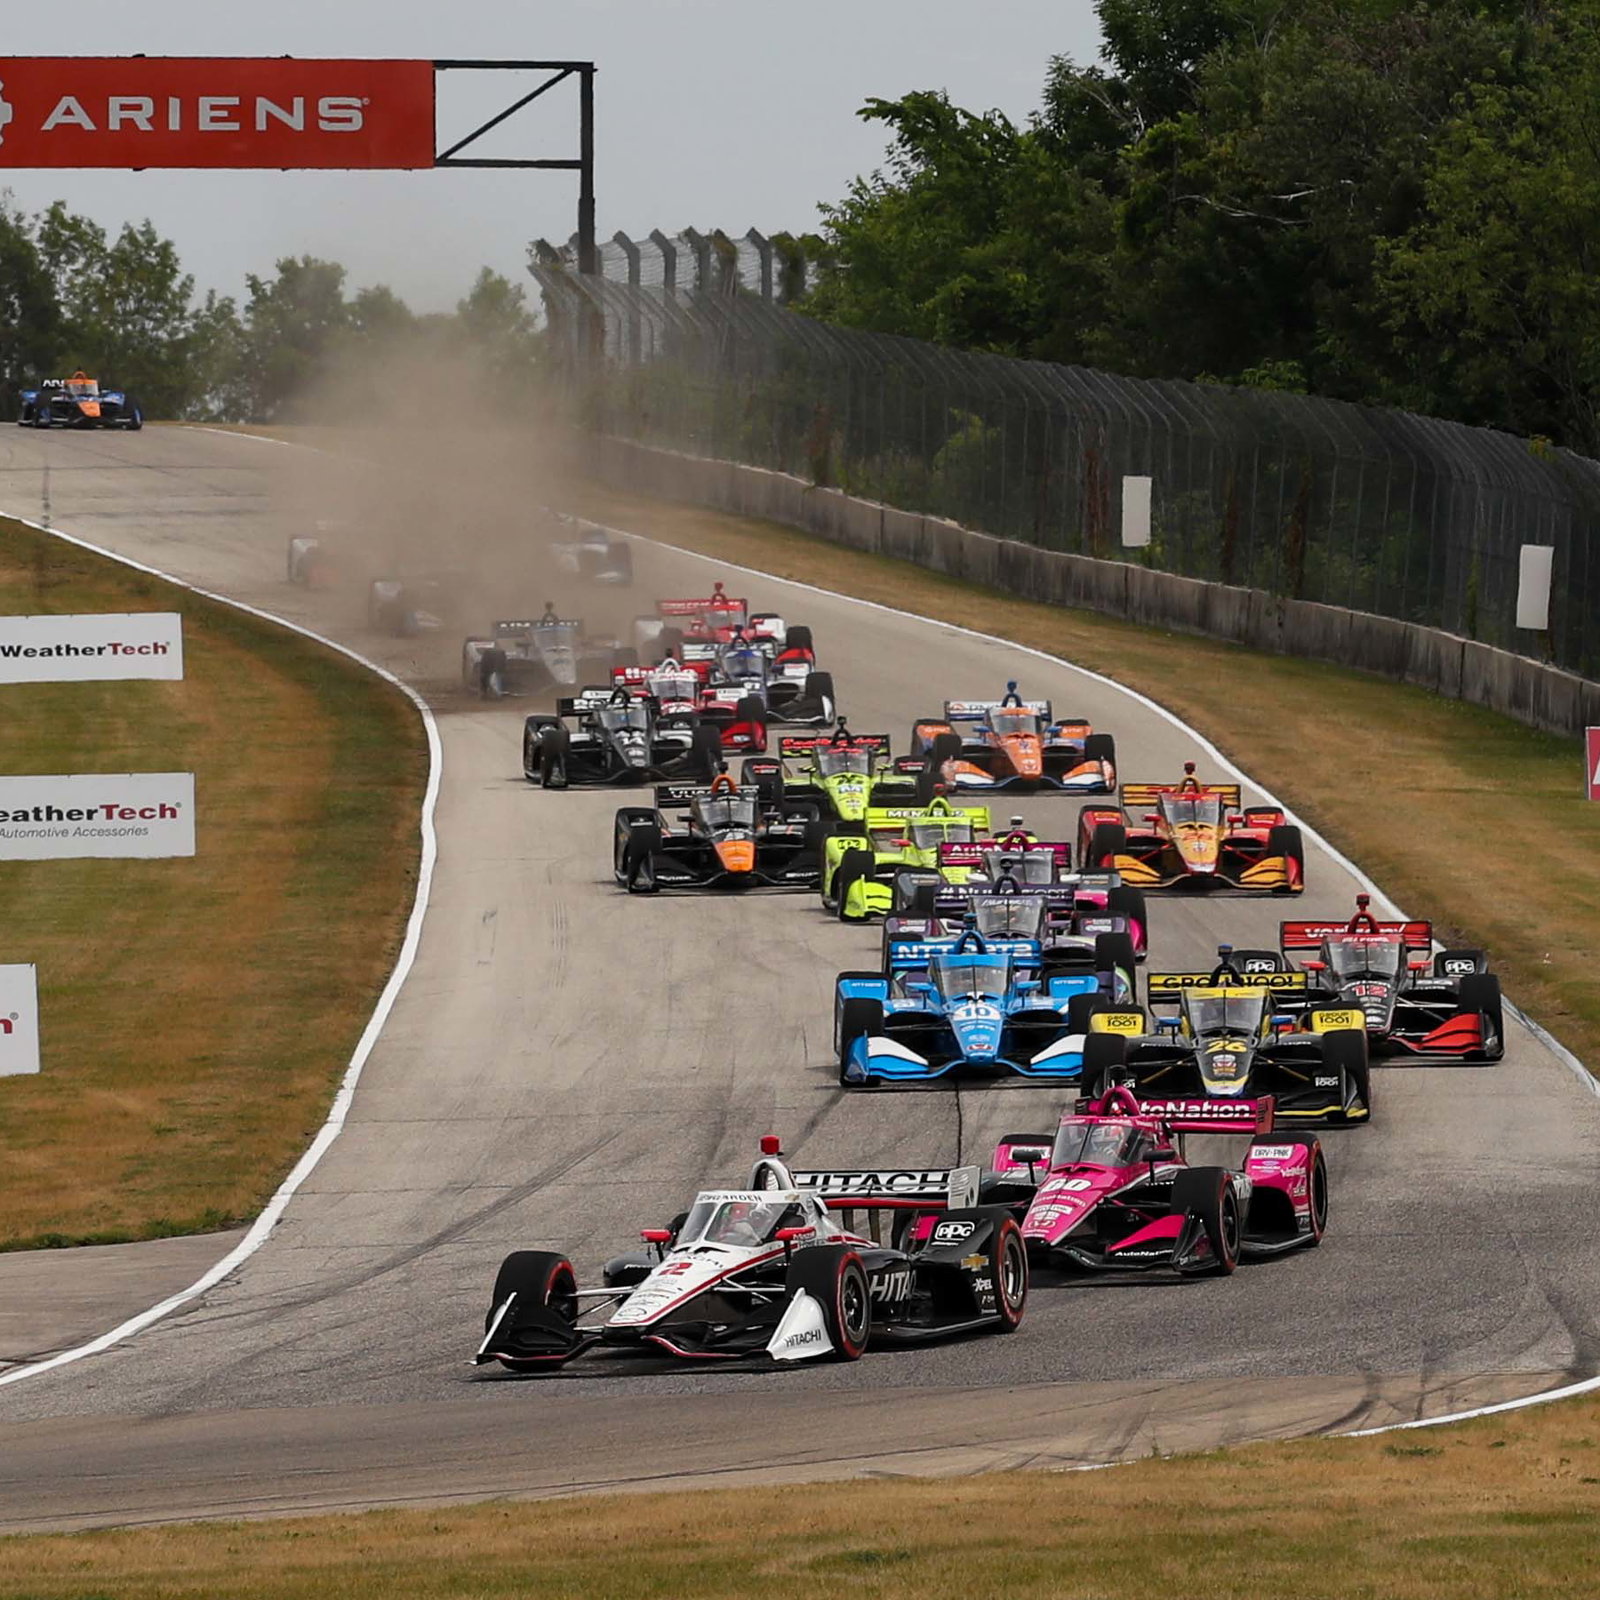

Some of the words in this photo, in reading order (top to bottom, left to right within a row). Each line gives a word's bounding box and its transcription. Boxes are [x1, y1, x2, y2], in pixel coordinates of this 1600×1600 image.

[41, 96, 364, 132] ARIENS
[0, 641, 167, 658] WeatherTech
[72, 826, 149, 838] Accessories
[1352, 984, 1388, 998] 12
[961, 1006, 991, 1017] 10
[1205, 1039, 1248, 1054] 26
[938, 1224, 972, 1238] PPG
[657, 1262, 694, 1276] 2
[785, 1329, 822, 1348] HITACHI
